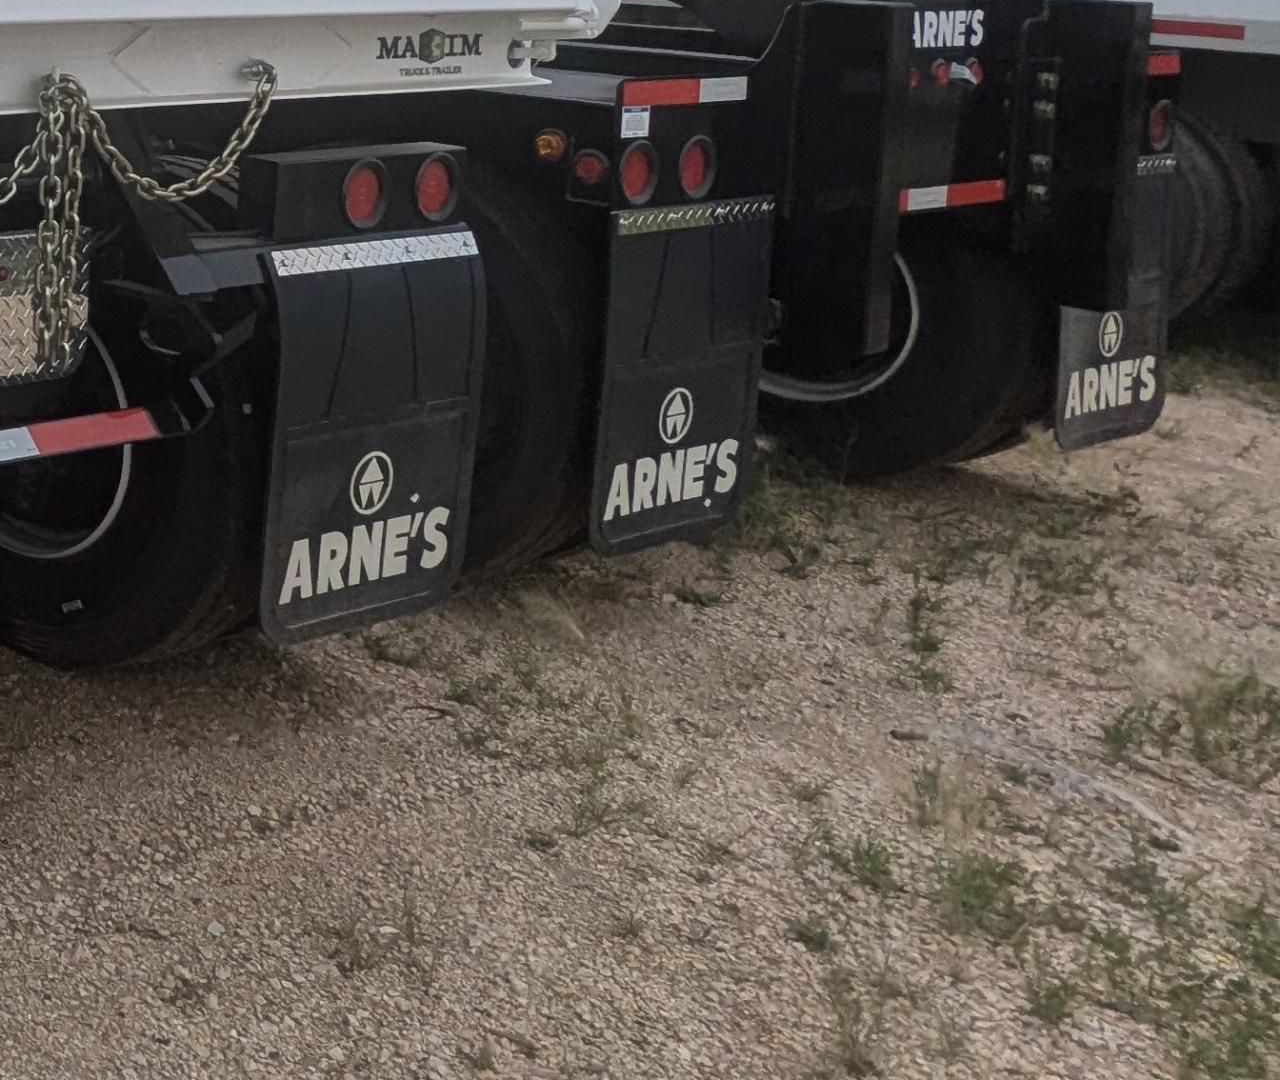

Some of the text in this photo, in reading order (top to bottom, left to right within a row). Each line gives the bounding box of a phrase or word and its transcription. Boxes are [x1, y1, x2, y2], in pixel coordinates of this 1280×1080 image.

[1064, 354, 1157, 419] ARNE'S
[603, 438, 738, 521] ARNE'S
[278, 506, 451, 605] ARNE'S
